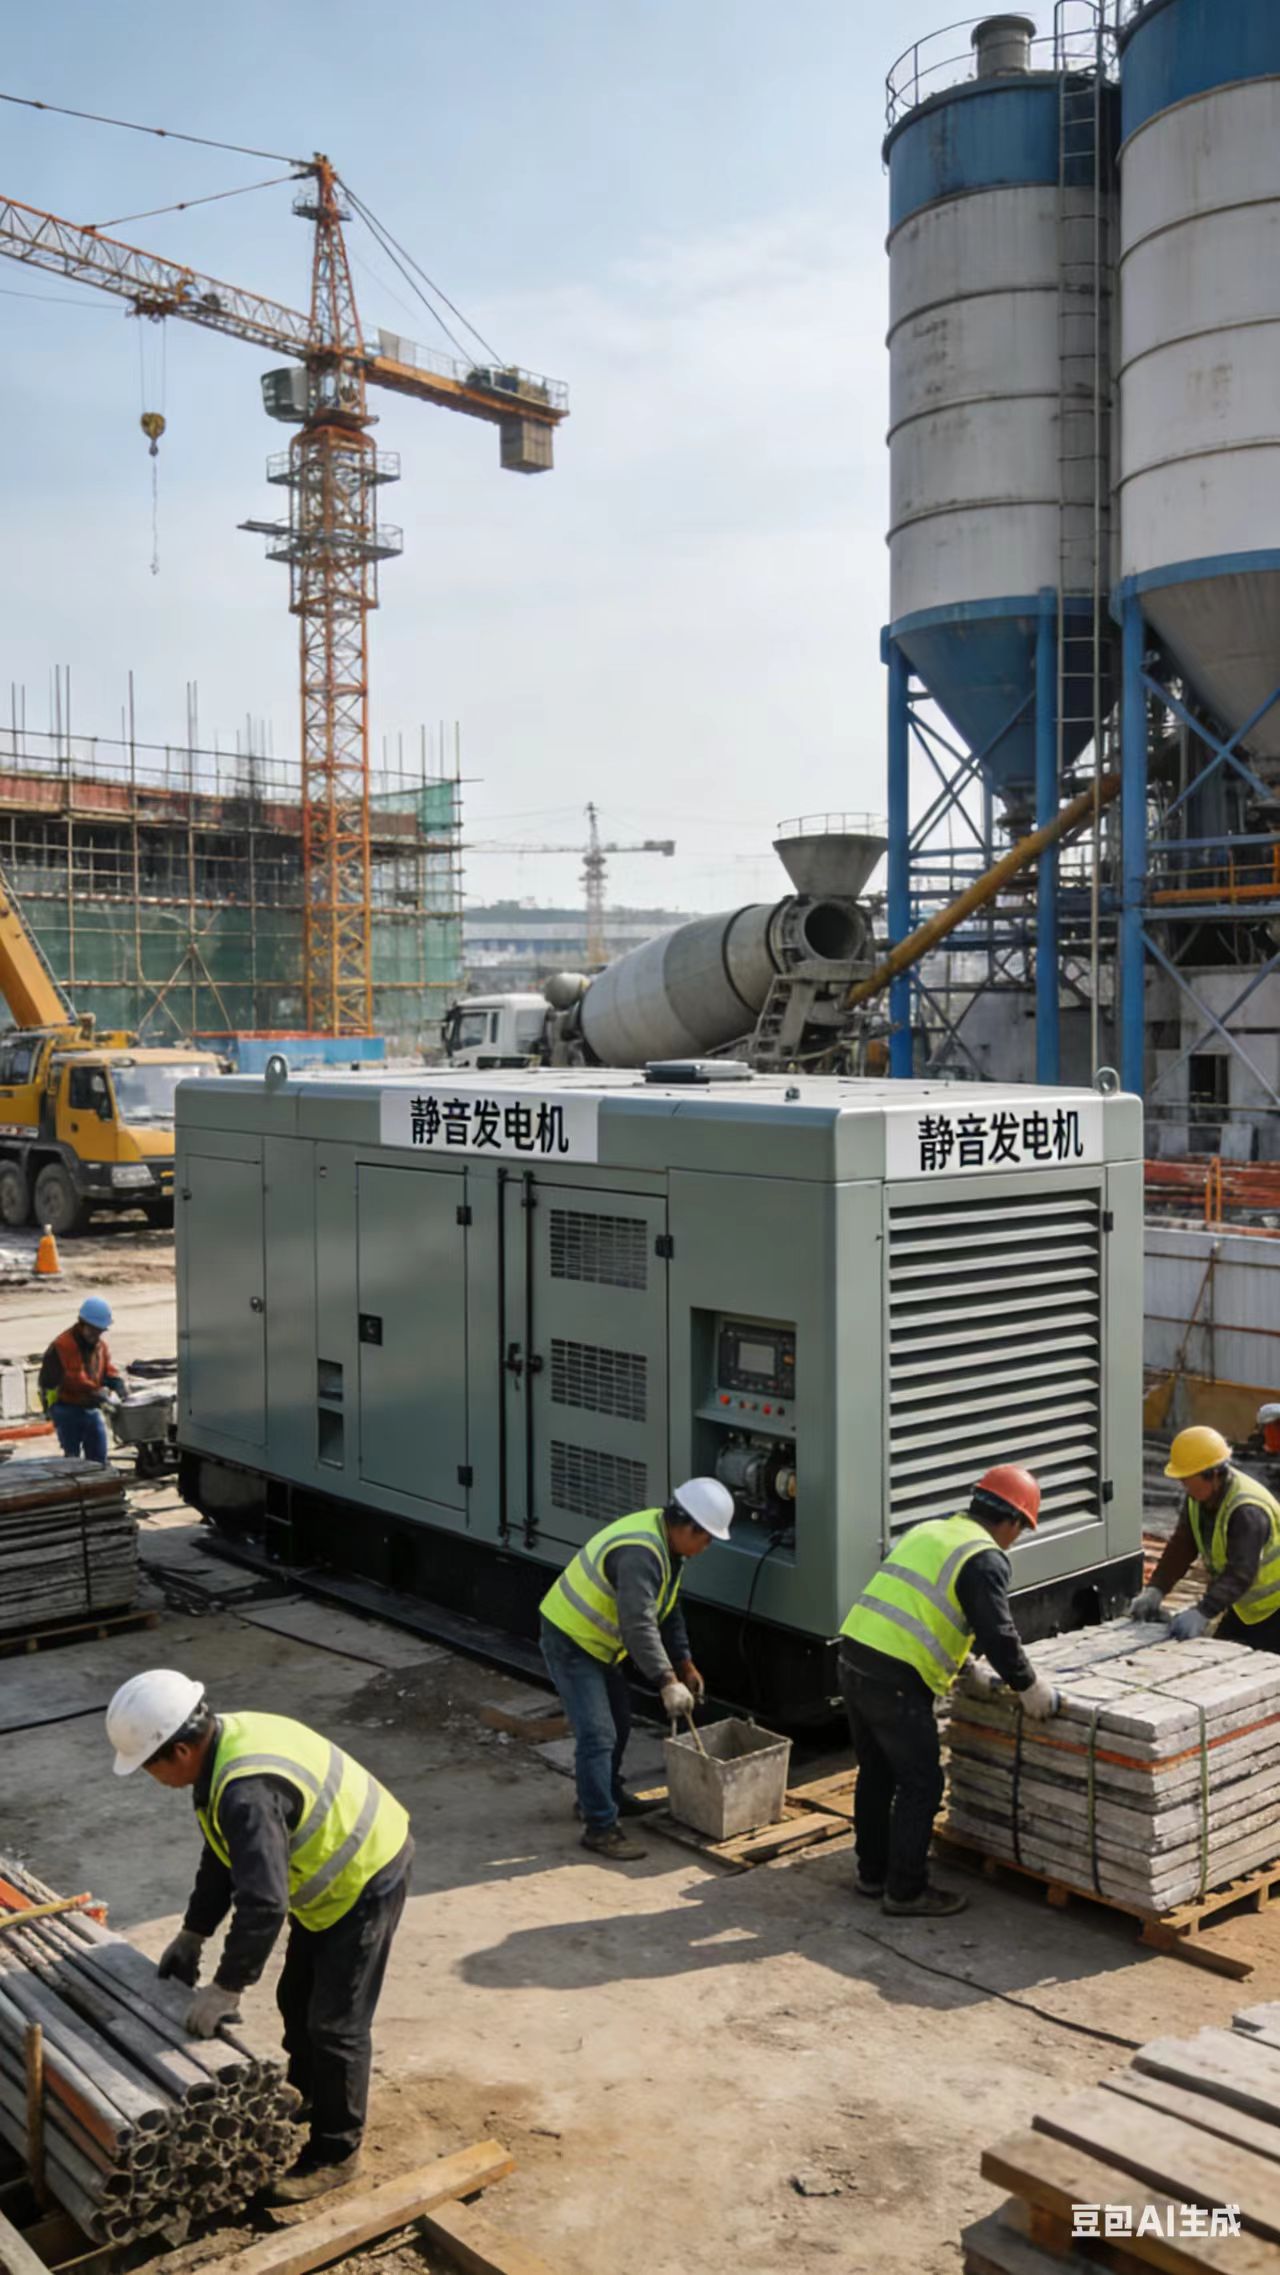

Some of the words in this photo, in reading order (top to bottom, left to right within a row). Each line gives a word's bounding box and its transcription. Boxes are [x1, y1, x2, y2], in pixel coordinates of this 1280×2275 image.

[410, 1095, 569, 1153] 静音发电机
[918, 1108, 1084, 1171] 静音发电机
